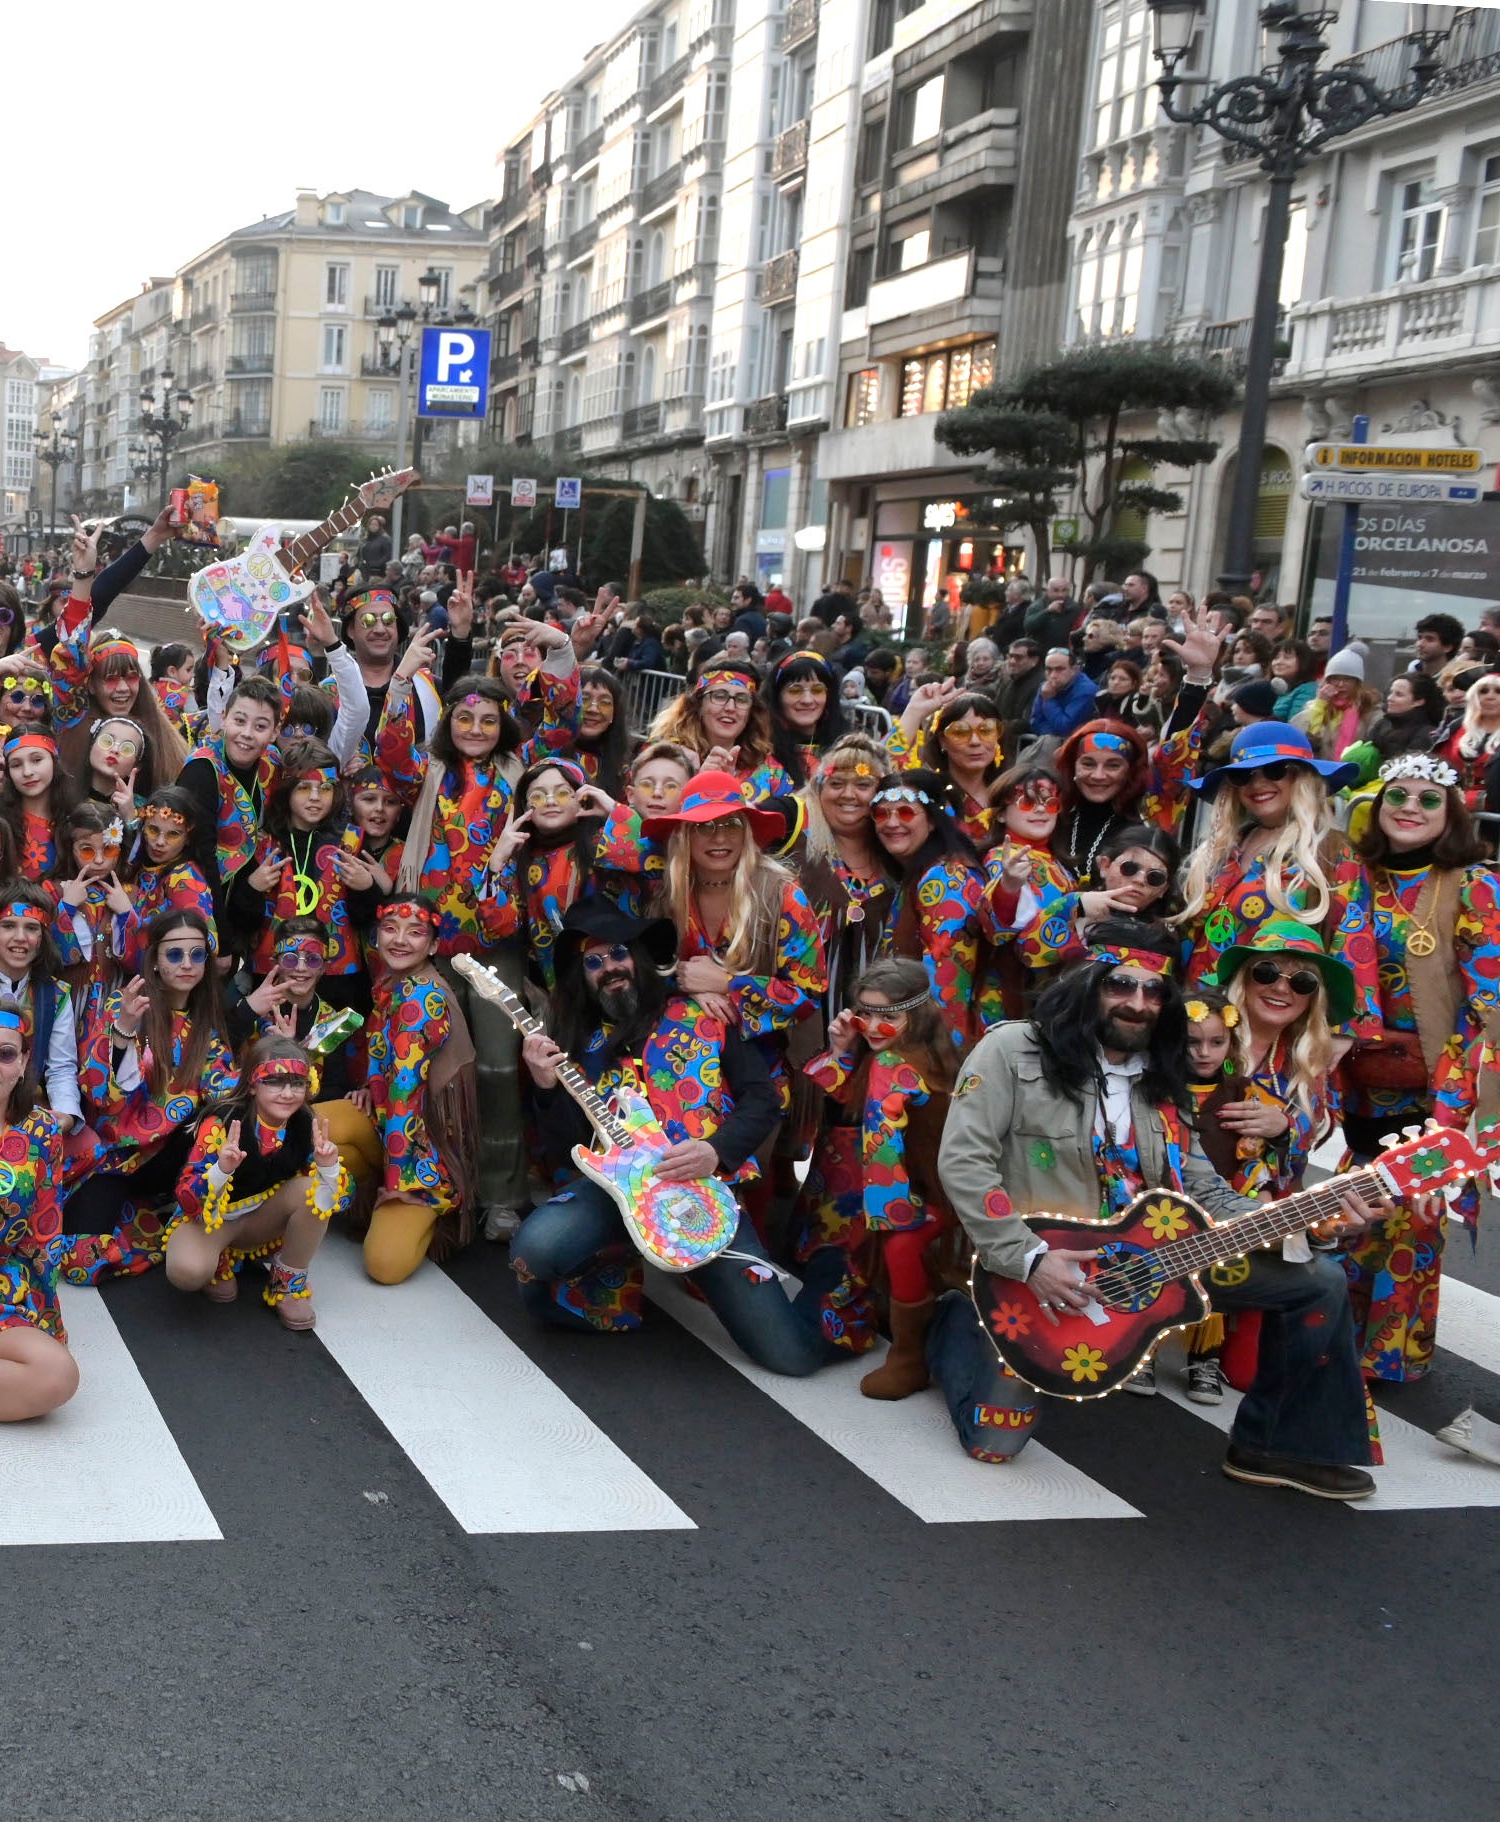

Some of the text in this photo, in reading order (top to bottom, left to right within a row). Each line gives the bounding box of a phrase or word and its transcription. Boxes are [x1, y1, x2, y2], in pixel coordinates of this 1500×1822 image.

[437, 332, 475, 382] P
[1341, 451, 1475, 468] INFORMACION HOTELES
[1378, 483, 1393, 497] DE
[1399, 483, 1442, 499] EUROPA
[1356, 514, 1427, 532] OS DÍAS
[1354, 536, 1489, 554] ORCELANOSA
[1380, 568, 1421, 578] febrero
[1431, 568, 1439, 578] 7
[1452, 571, 1488, 580] marzo
